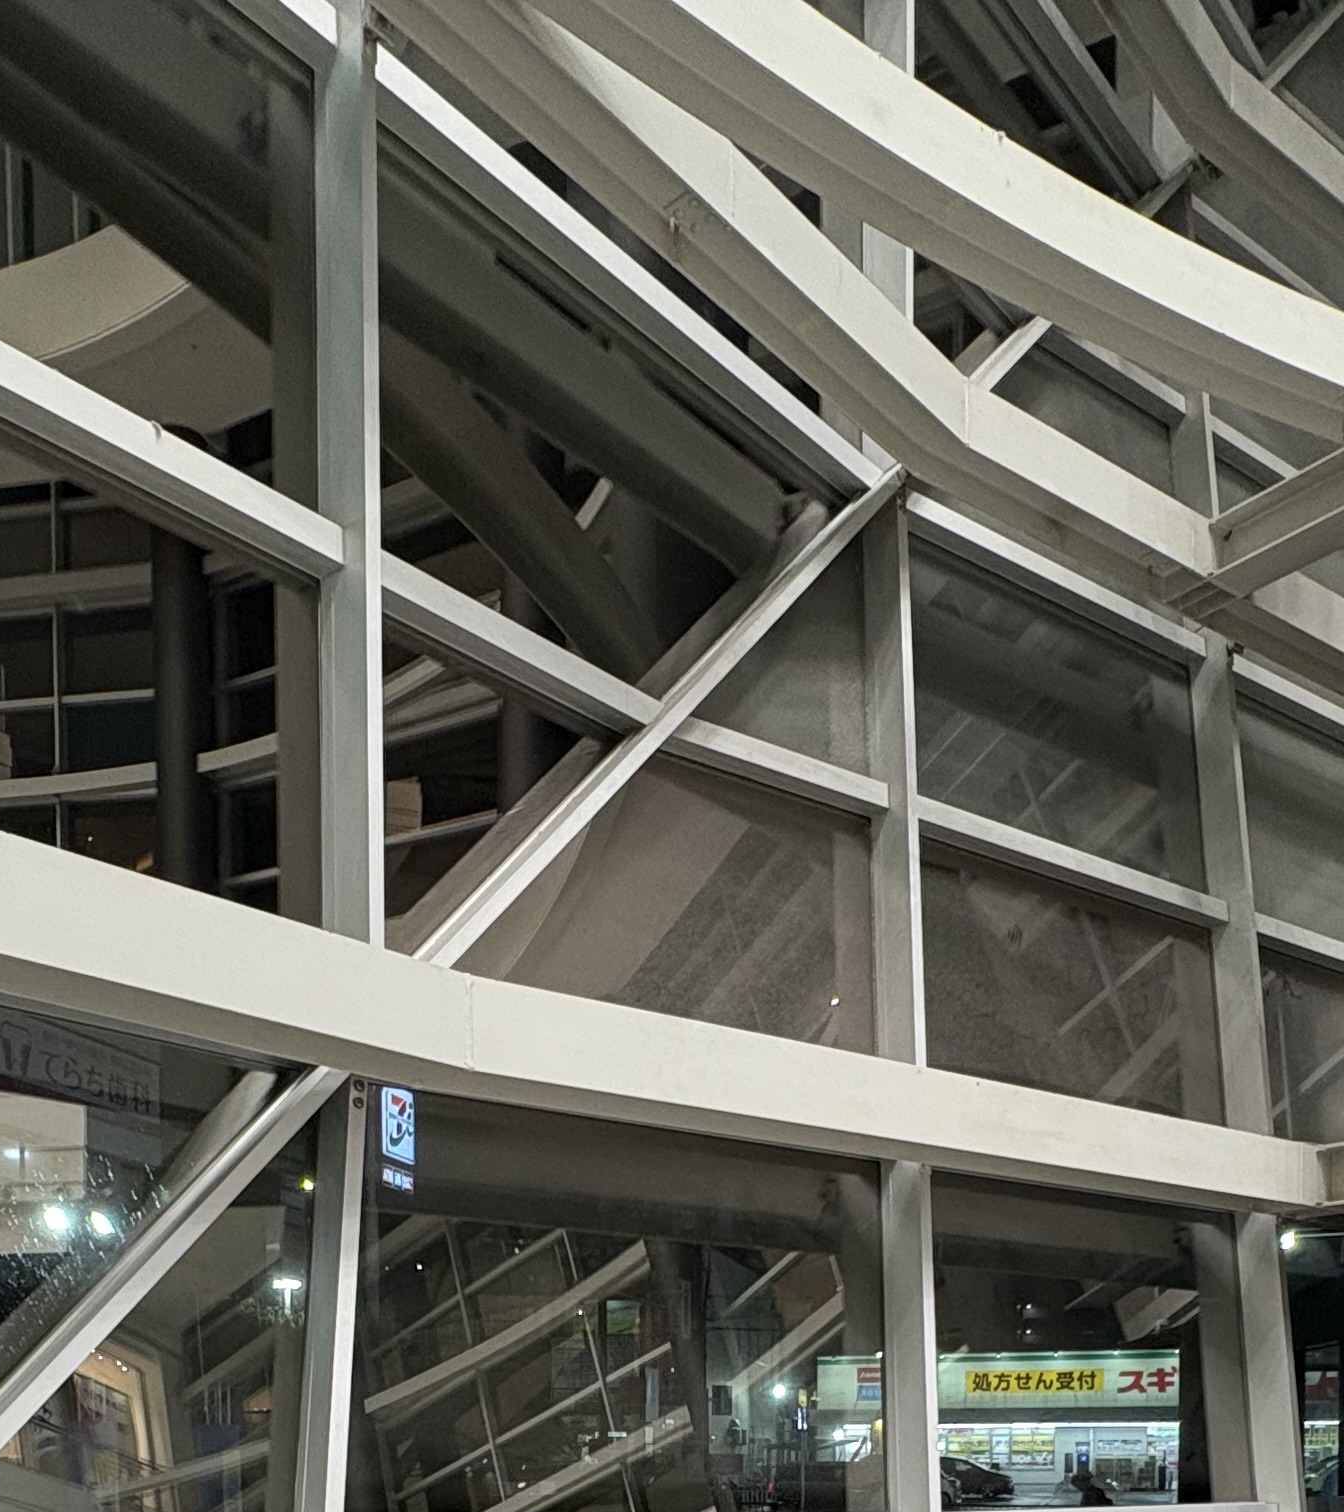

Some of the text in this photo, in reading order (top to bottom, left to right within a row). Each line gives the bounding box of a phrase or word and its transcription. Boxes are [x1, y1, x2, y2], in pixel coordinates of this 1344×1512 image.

[972, 1366, 1178, 1394] 処方せん受付 スギ
